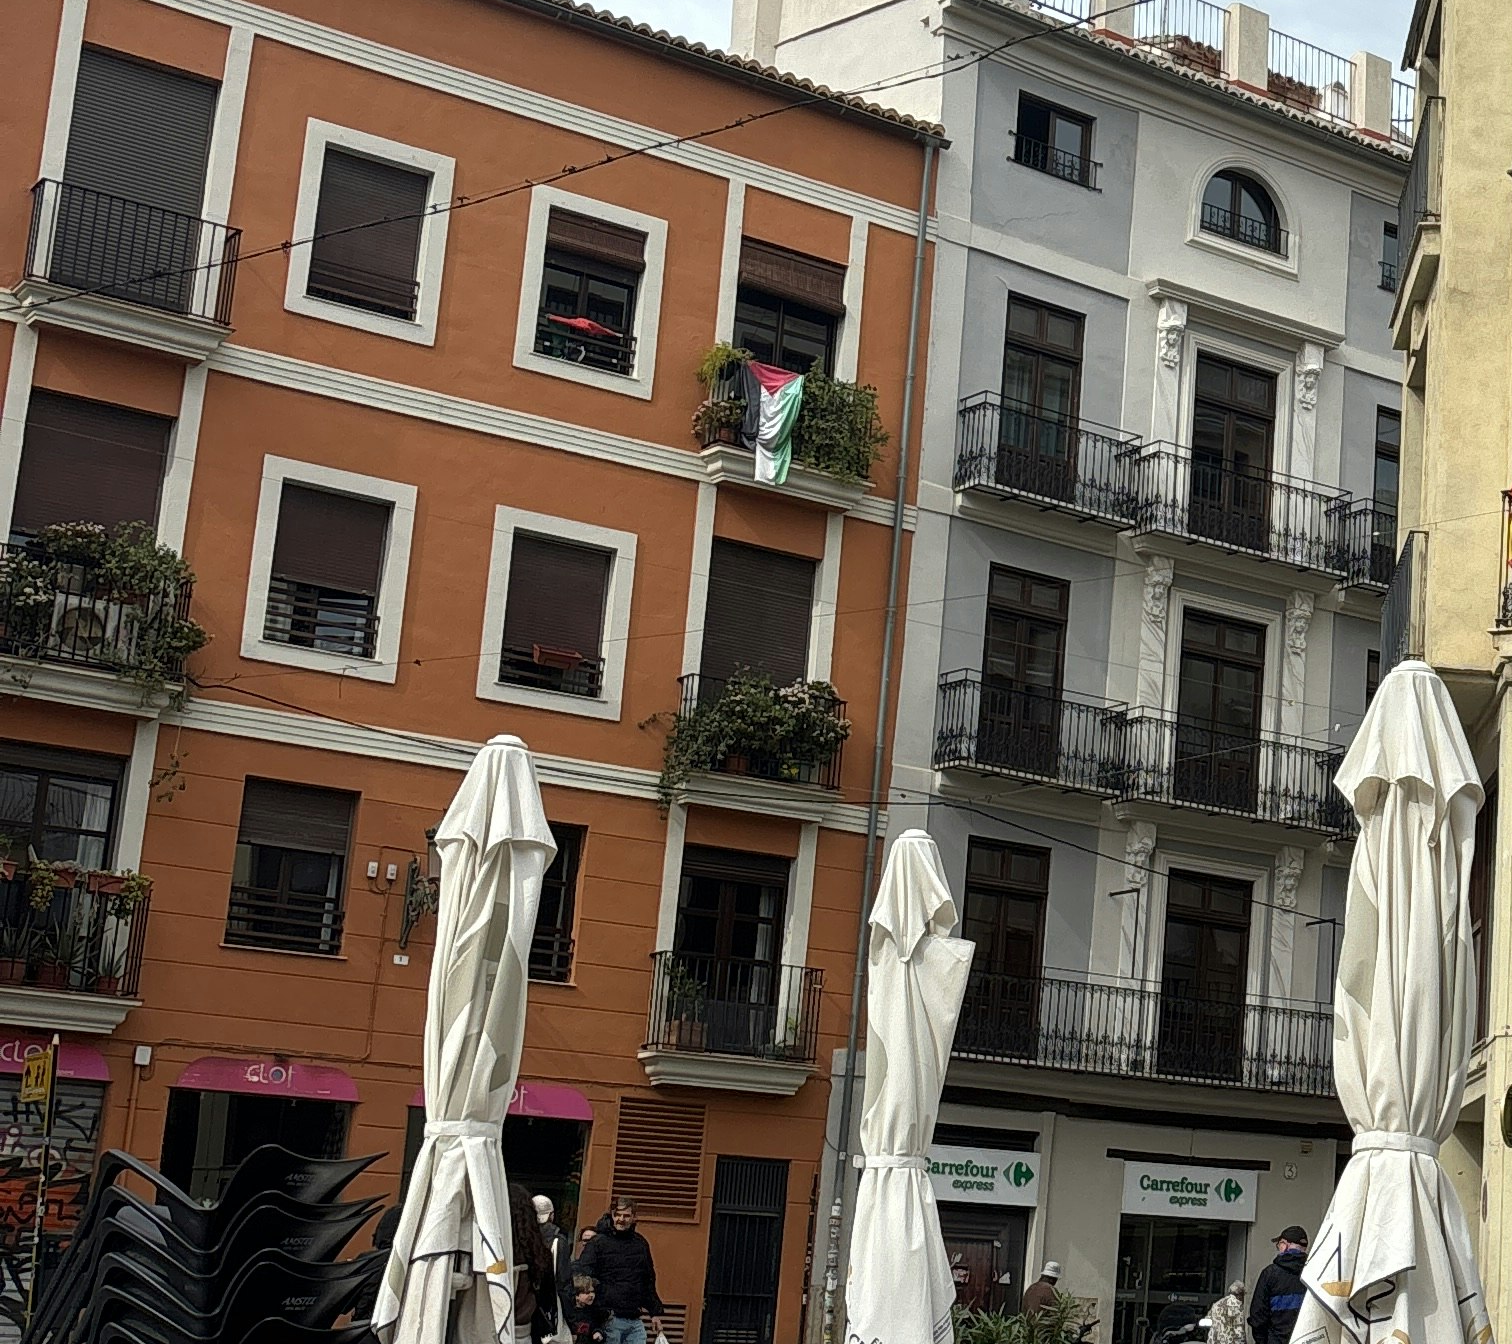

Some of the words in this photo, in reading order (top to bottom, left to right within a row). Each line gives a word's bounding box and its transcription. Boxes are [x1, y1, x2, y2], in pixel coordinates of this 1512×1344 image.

[924, 1156, 998, 1178] Carrefour
[952, 1178, 995, 1192] express
[1139, 1174, 1211, 1195] Carrefour
[1168, 1195, 1208, 1208] express
